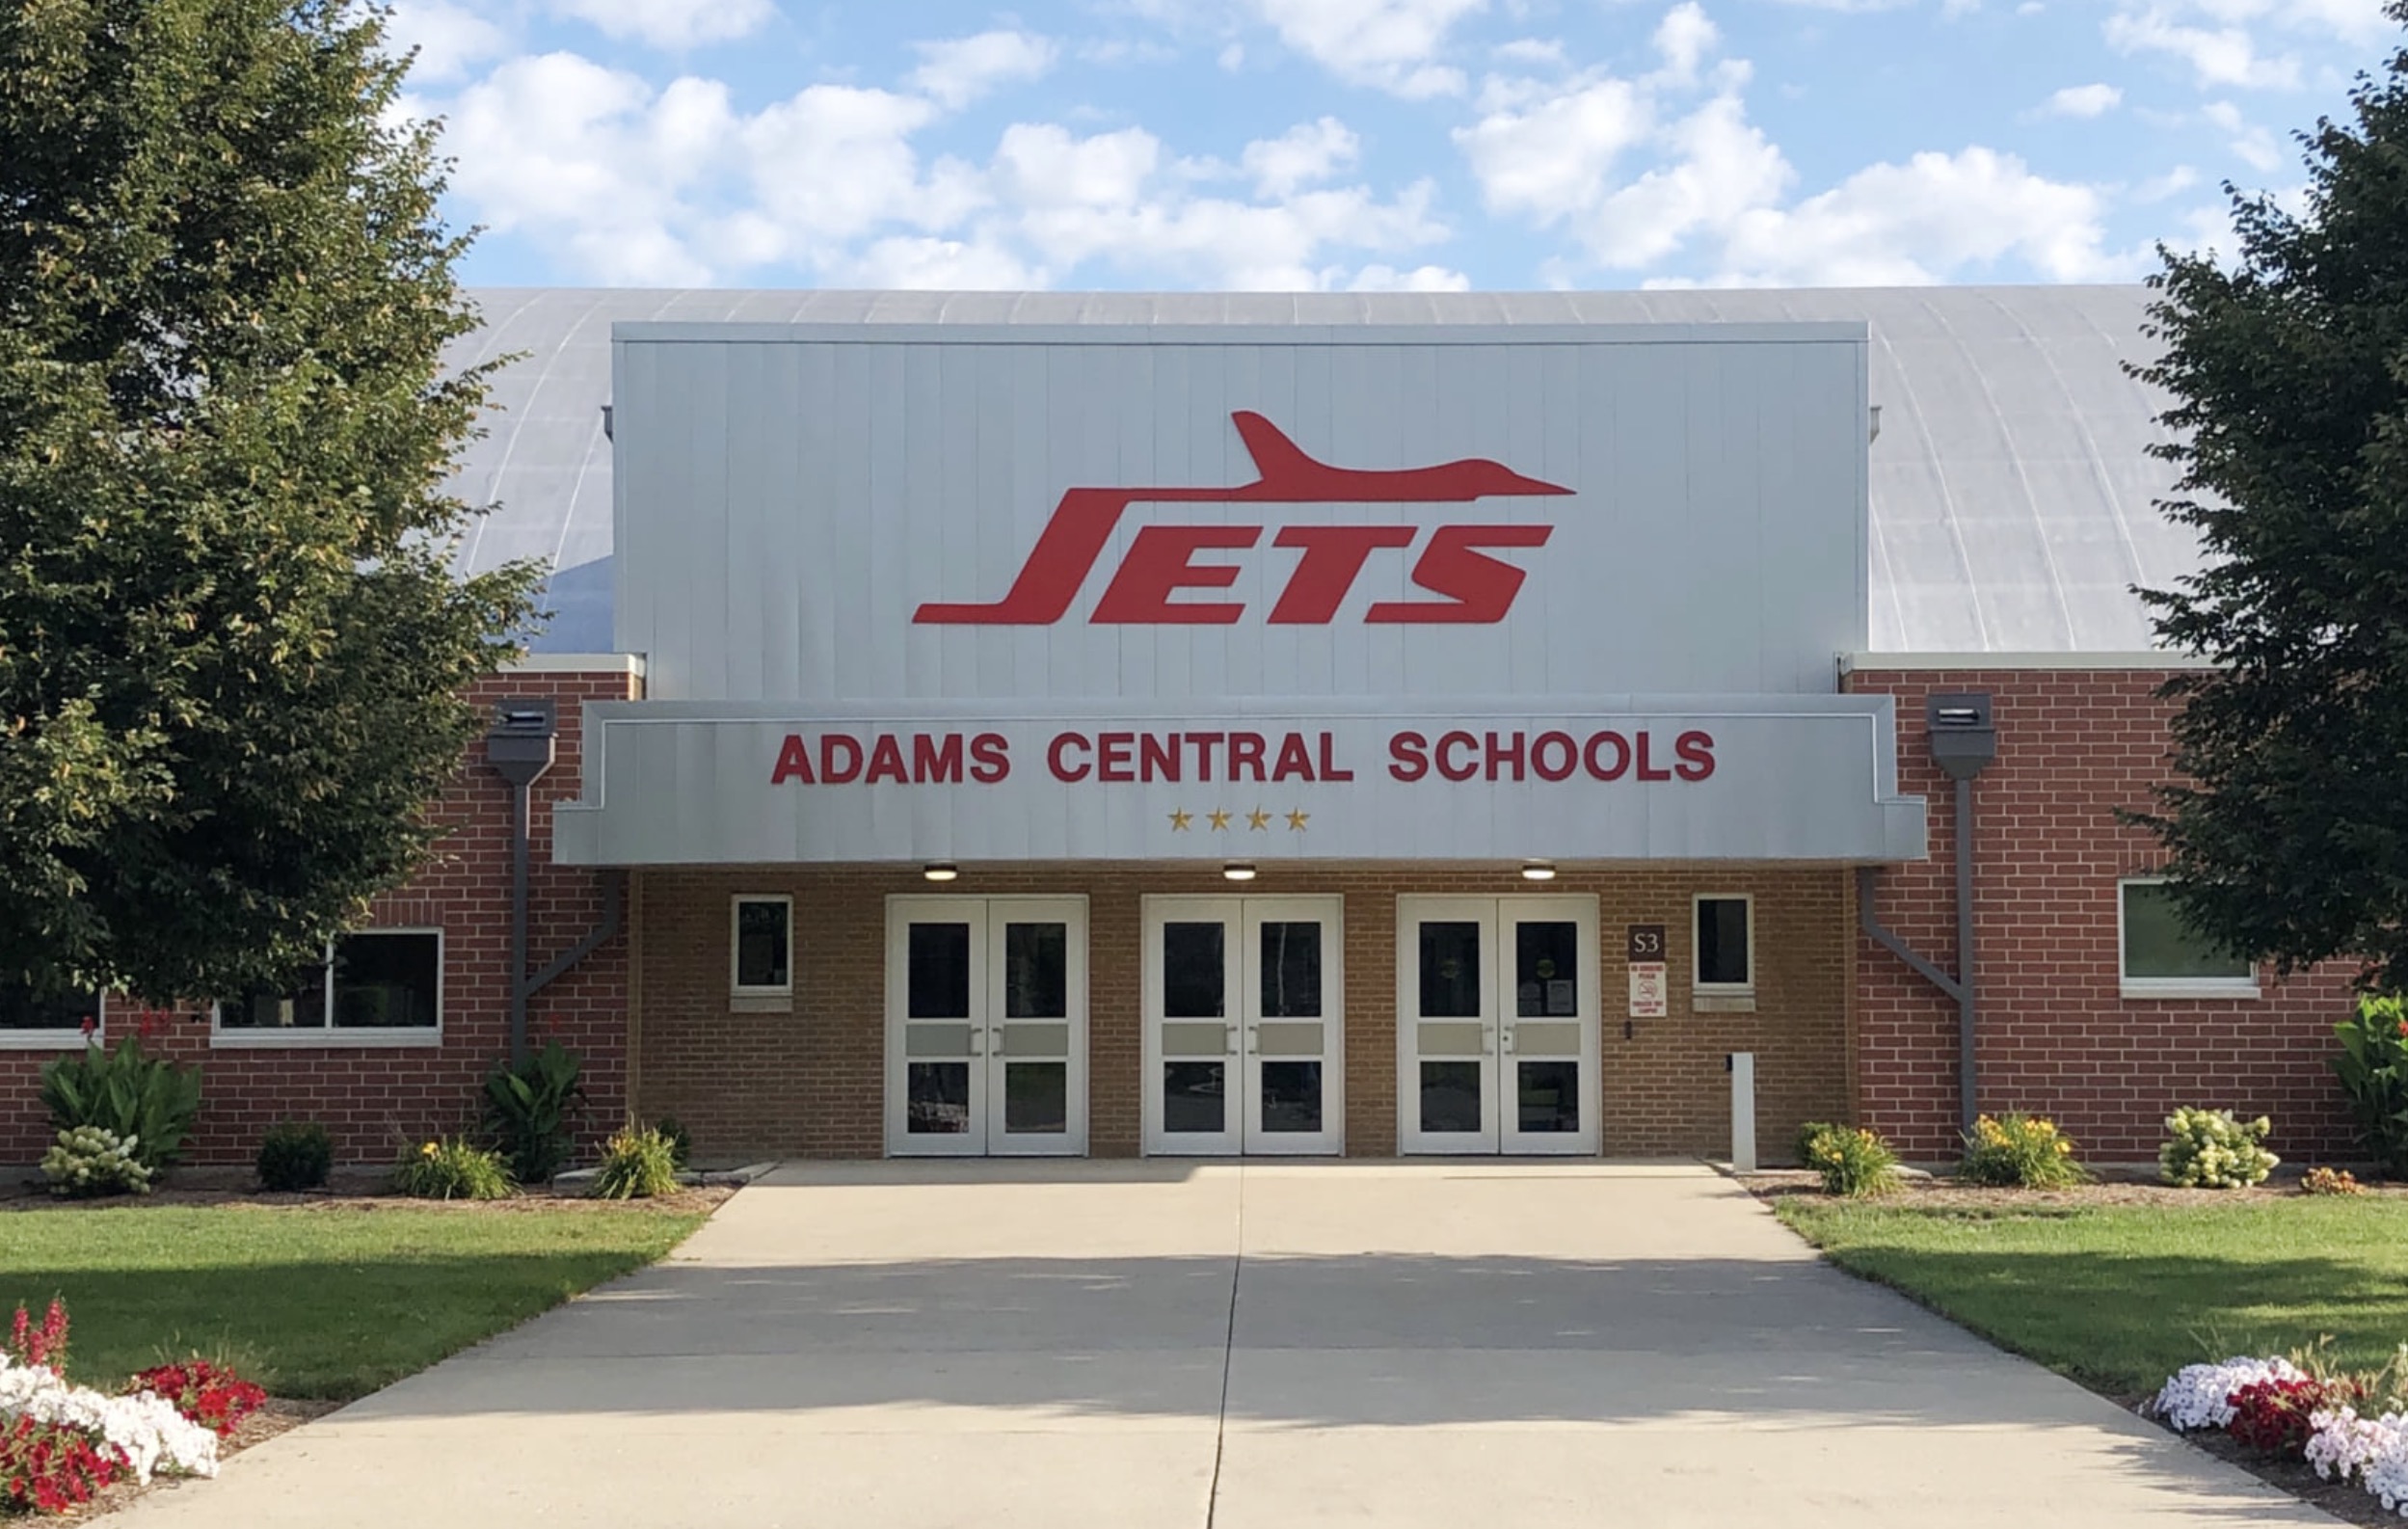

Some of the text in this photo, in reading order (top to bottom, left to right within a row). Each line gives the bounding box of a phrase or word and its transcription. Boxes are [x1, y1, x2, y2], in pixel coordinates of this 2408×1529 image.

[913, 487, 1554, 625] JETS
[771, 730, 1715, 785] ADAMS CENTRAL SCHOOLS
[1634, 932, 1660, 953] S3
